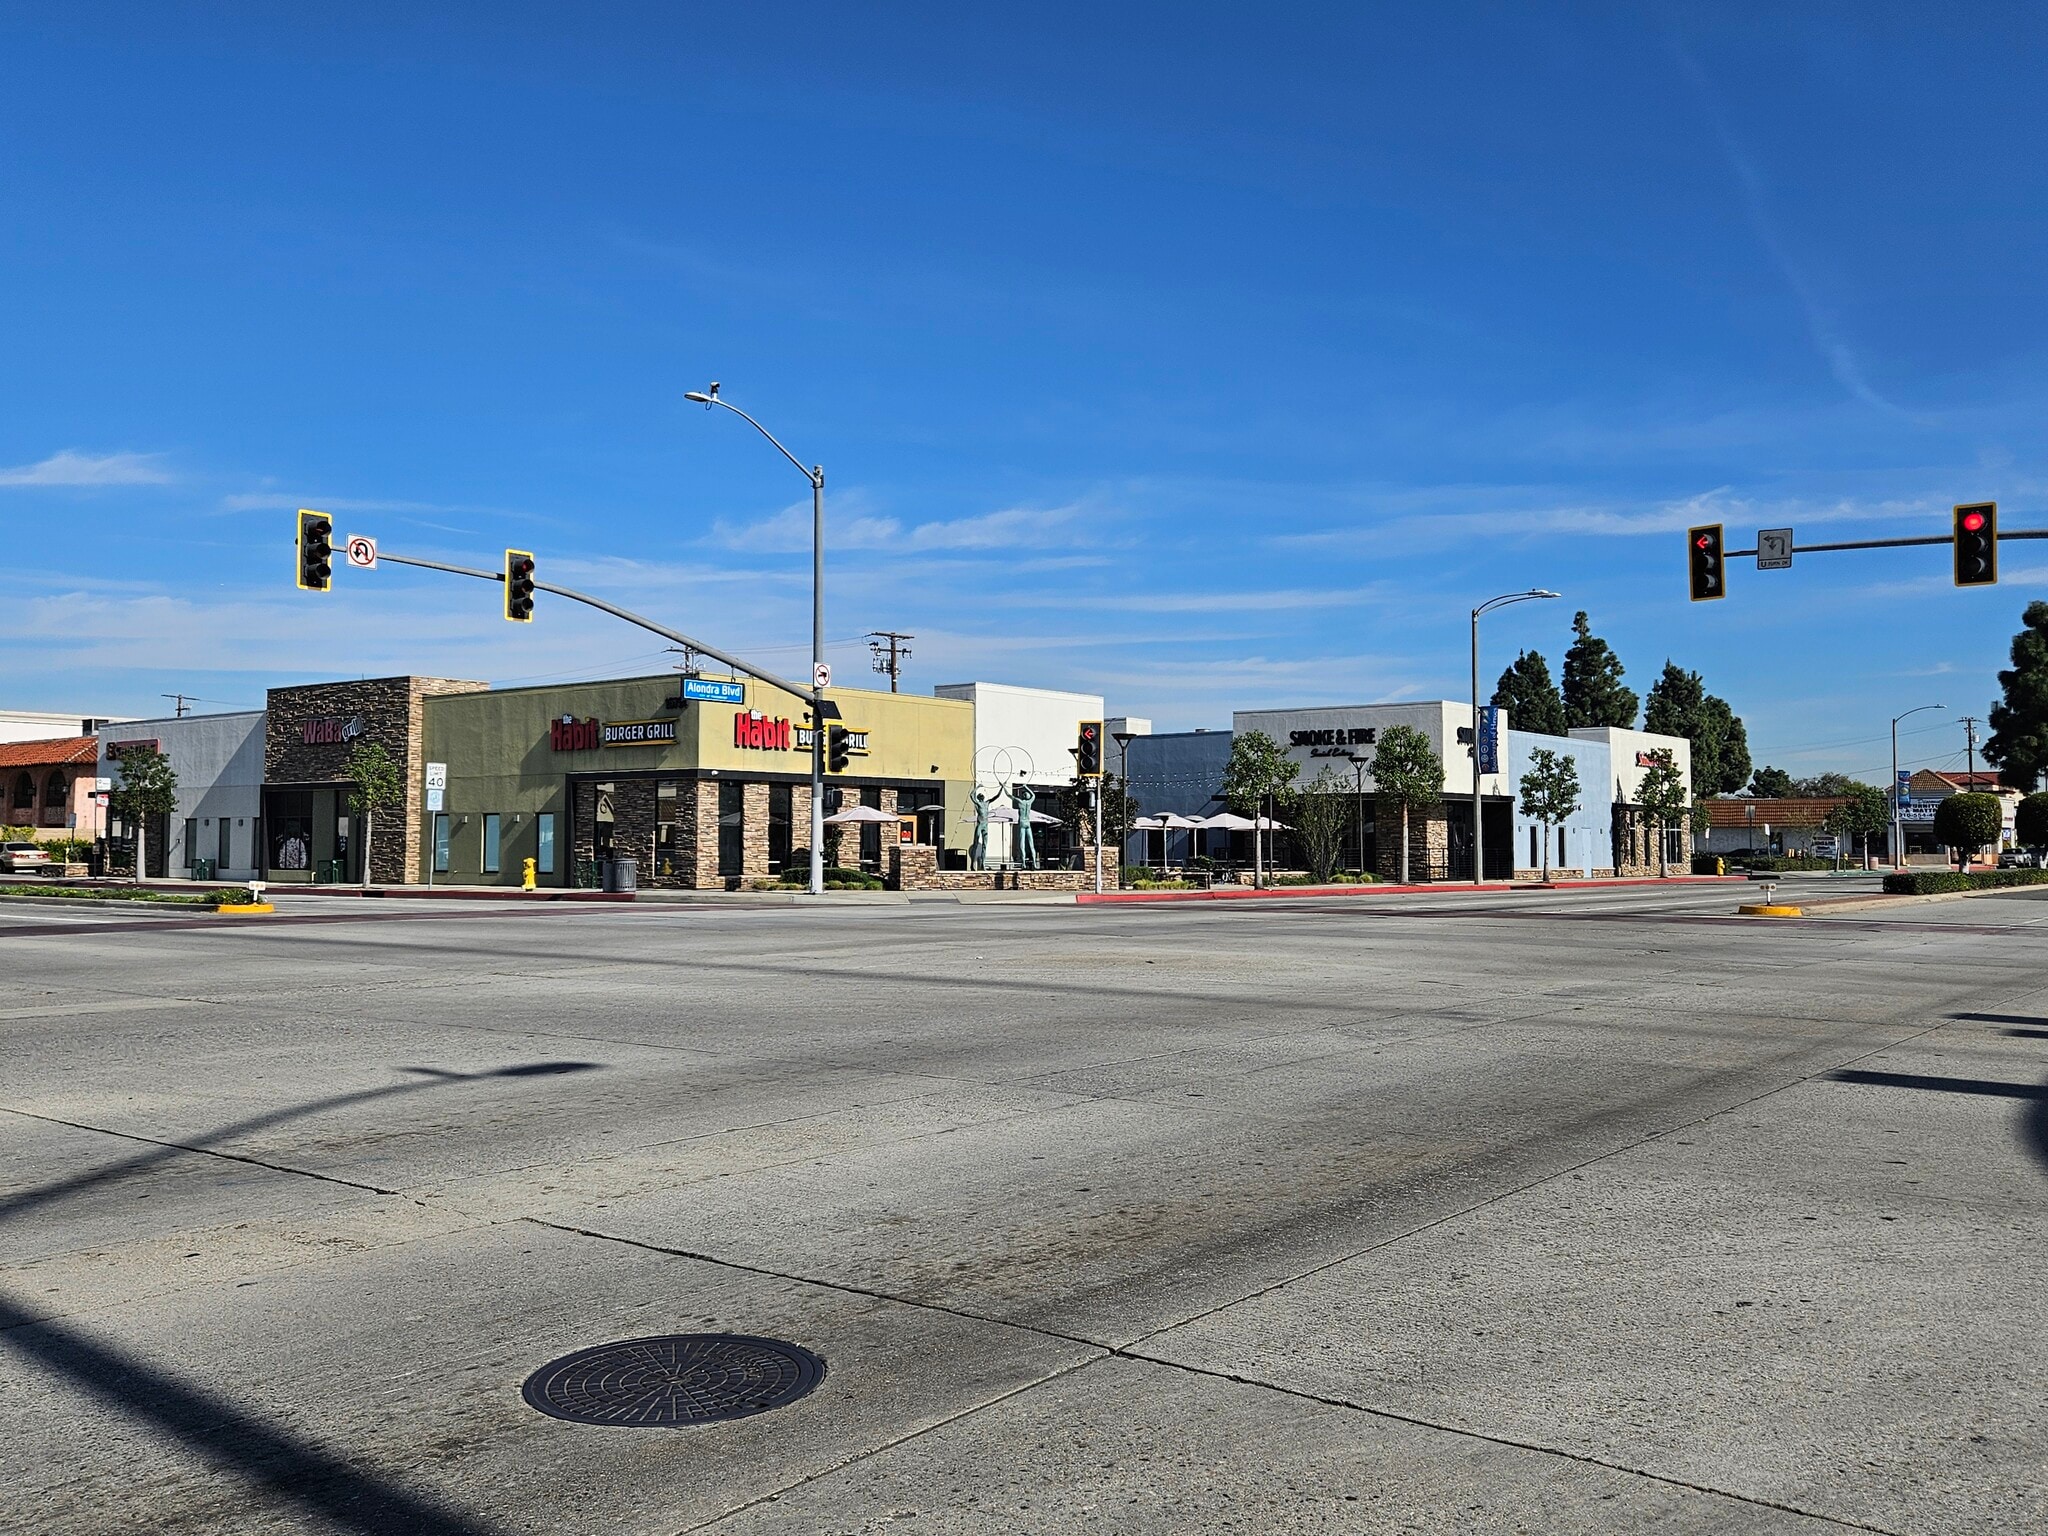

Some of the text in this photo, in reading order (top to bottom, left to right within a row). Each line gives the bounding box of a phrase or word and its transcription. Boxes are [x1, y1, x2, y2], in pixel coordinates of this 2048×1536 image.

[687, 682, 741, 697] Alondra Blvd
[750, 709, 762, 720] the
[550, 717, 598, 751] Habit
[605, 723, 675, 741] BURGER GRILL
[735, 712, 790, 749] Habit
[1289, 727, 1376, 746] SMOKE & FIRE
[428, 777, 443, 787] 40
